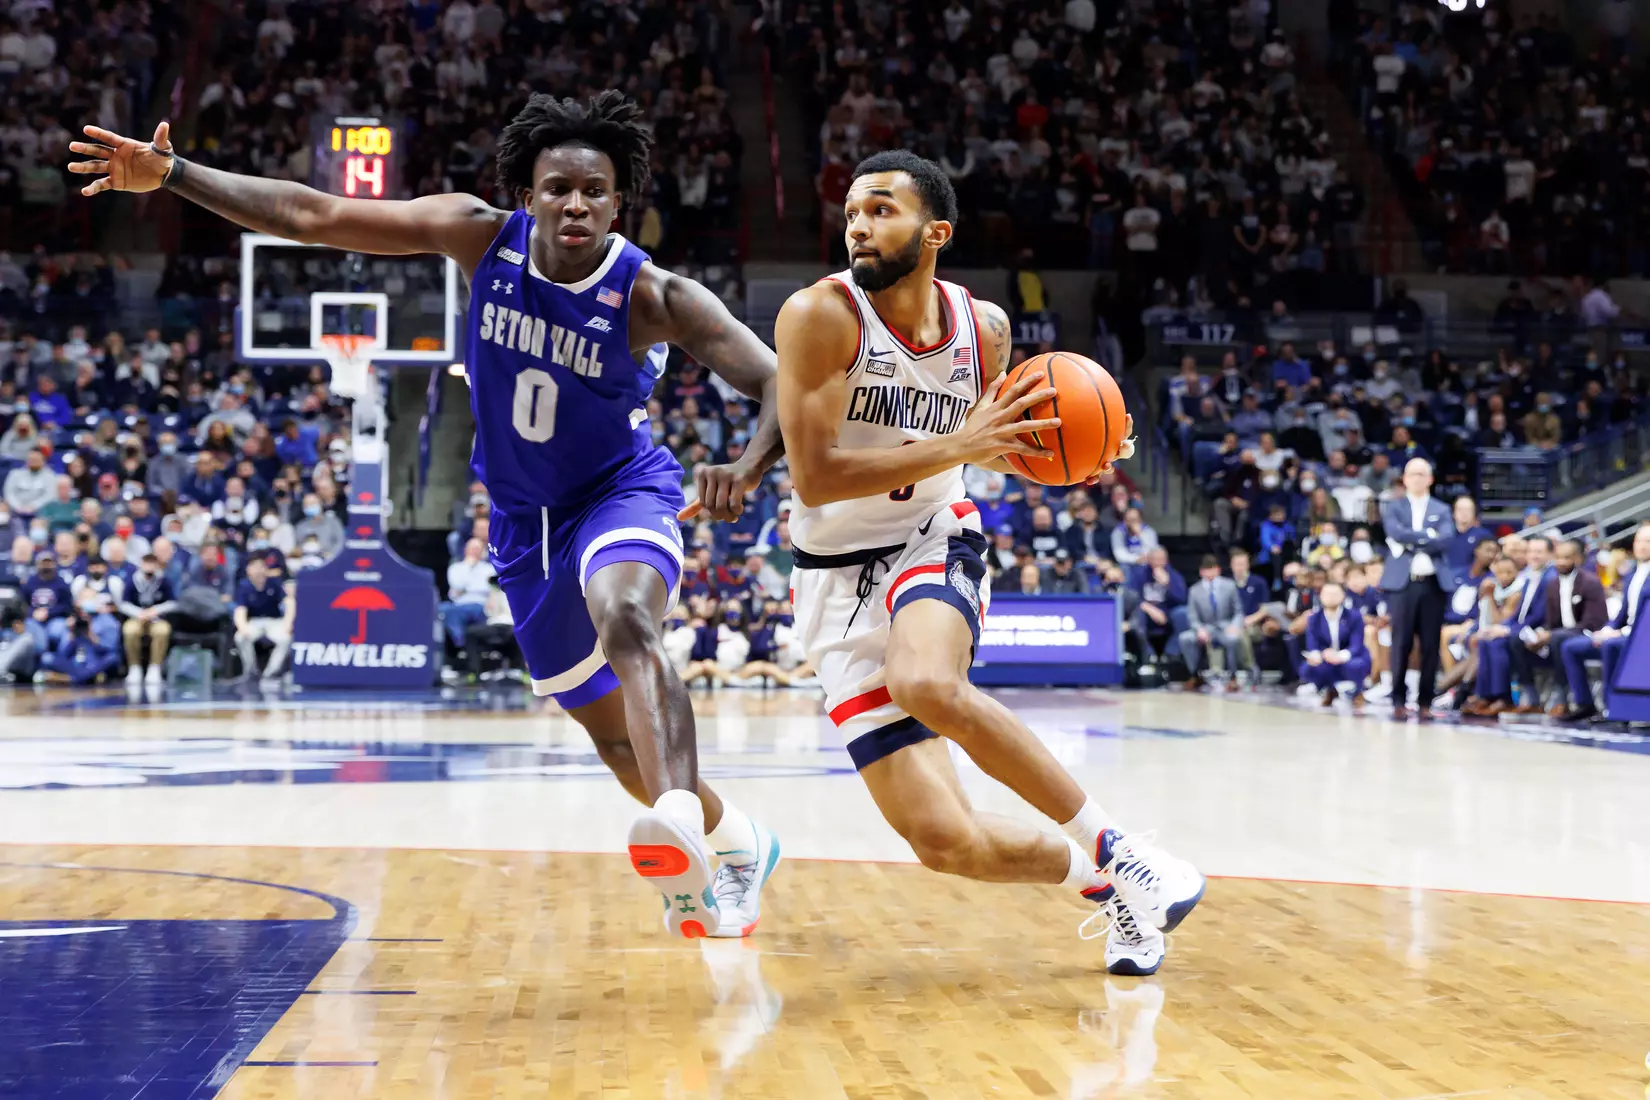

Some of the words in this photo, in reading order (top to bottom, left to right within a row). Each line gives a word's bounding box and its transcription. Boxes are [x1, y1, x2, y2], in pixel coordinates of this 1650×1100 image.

[331, 127, 392, 155] 11:00
[345, 156, 384, 197] 14
[479, 301, 547, 359] SETON
[550, 323, 603, 378] HALL
[1200, 323, 1236, 343] 117
[512, 367, 559, 444] 0
[847, 385, 971, 435] CONNECTICUT
[291, 641, 428, 668] TRAVELERS
